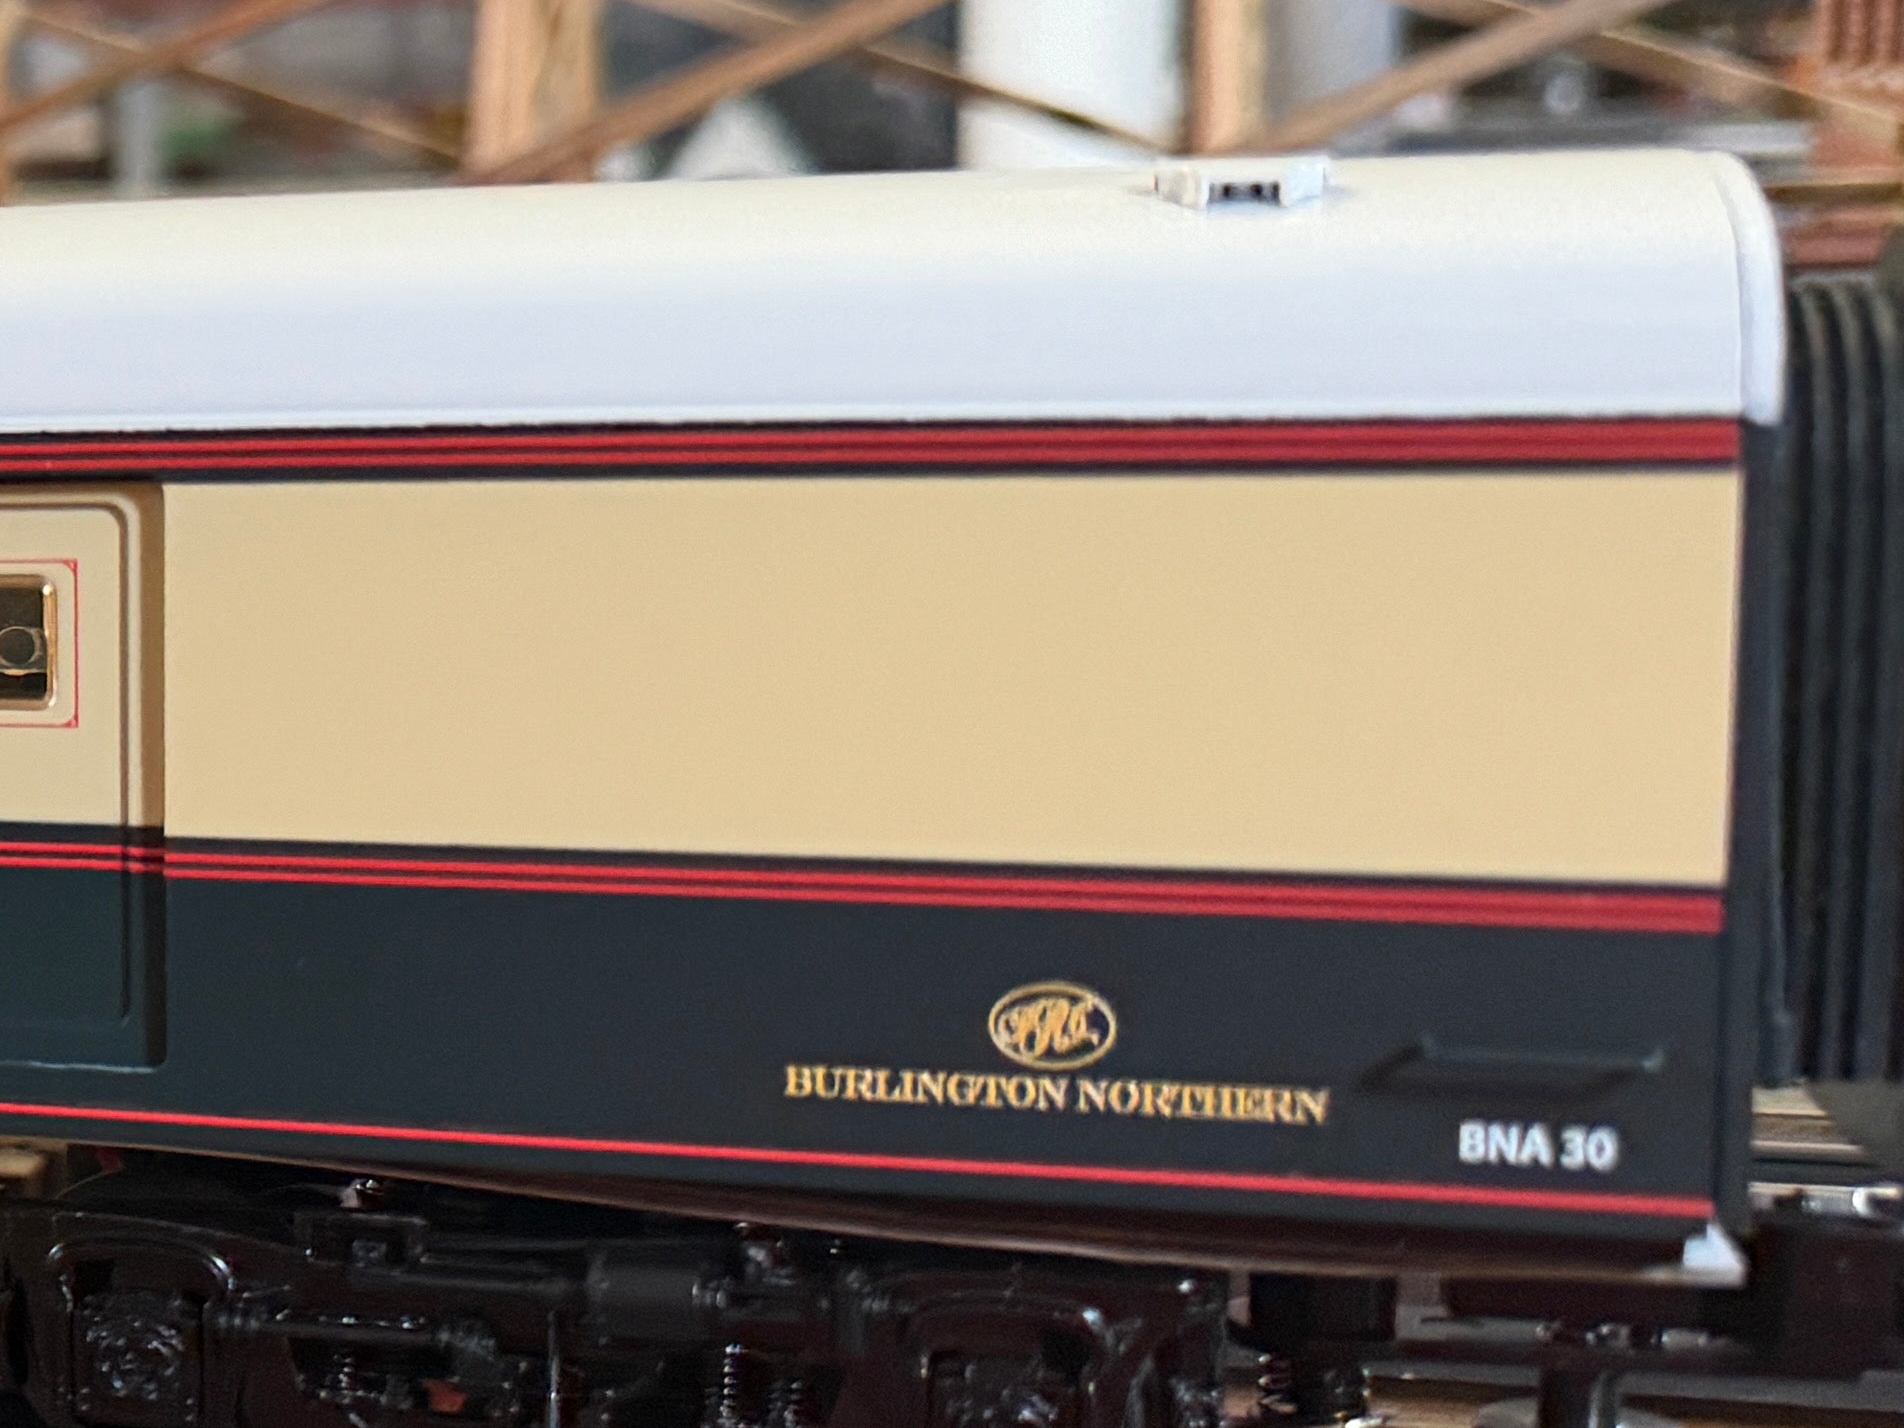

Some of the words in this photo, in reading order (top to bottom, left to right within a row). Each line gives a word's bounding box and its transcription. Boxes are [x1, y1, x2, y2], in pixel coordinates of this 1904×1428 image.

[783, 1064, 1069, 1112] BURLINGTON
[1075, 1076, 1330, 1126] NORTHERN
[1458, 1120, 1554, 1168] BNA
[1559, 1125, 1619, 1171] 30
